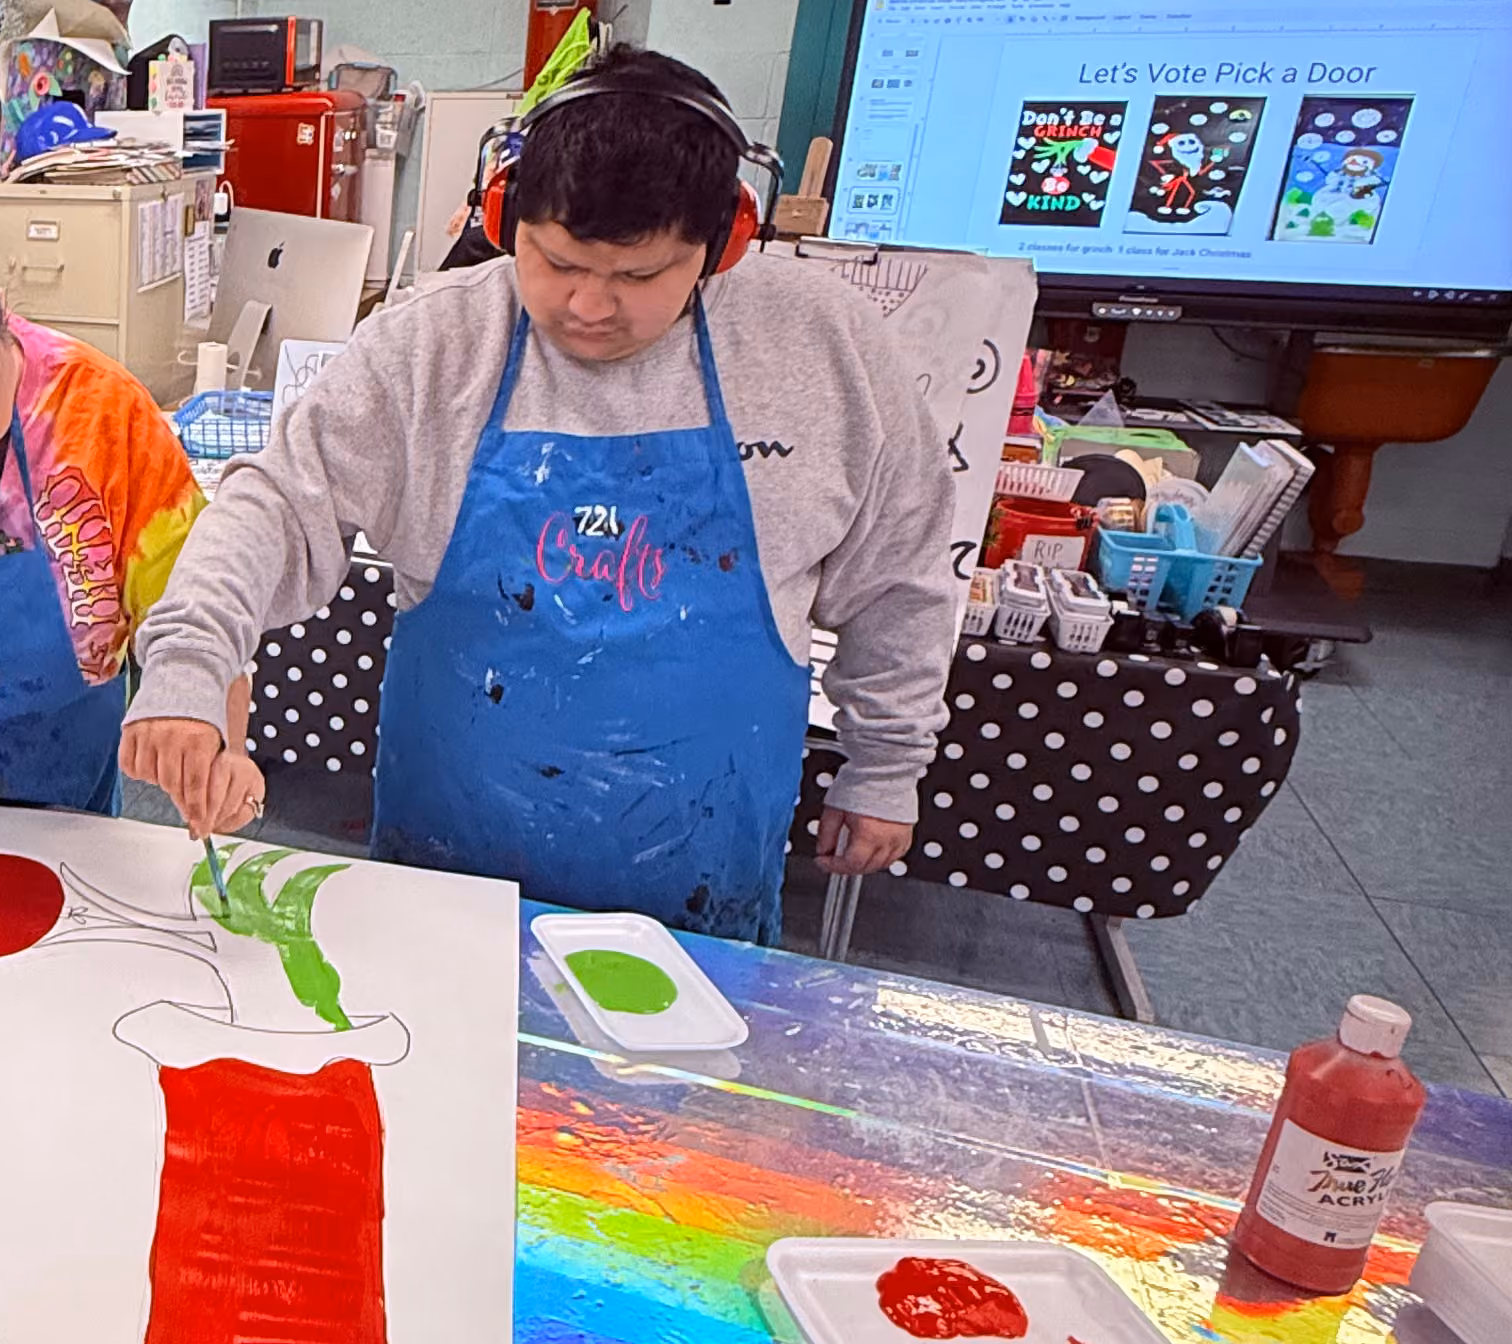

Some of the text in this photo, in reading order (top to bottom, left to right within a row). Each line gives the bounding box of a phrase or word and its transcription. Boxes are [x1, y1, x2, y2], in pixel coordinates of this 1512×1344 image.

[1079, 61, 1377, 84] Let's Vote Pick a Door
[1022, 107, 1075, 126] Don't
[1034, 125, 1102, 138] GRINCH
[1027, 195, 1081, 211] KIND
[574, 504, 619, 537] 721
[1033, 540, 1064, 561] RIP
[536, 511, 668, 613] Crafts
[1308, 1169, 1366, 1194] True
